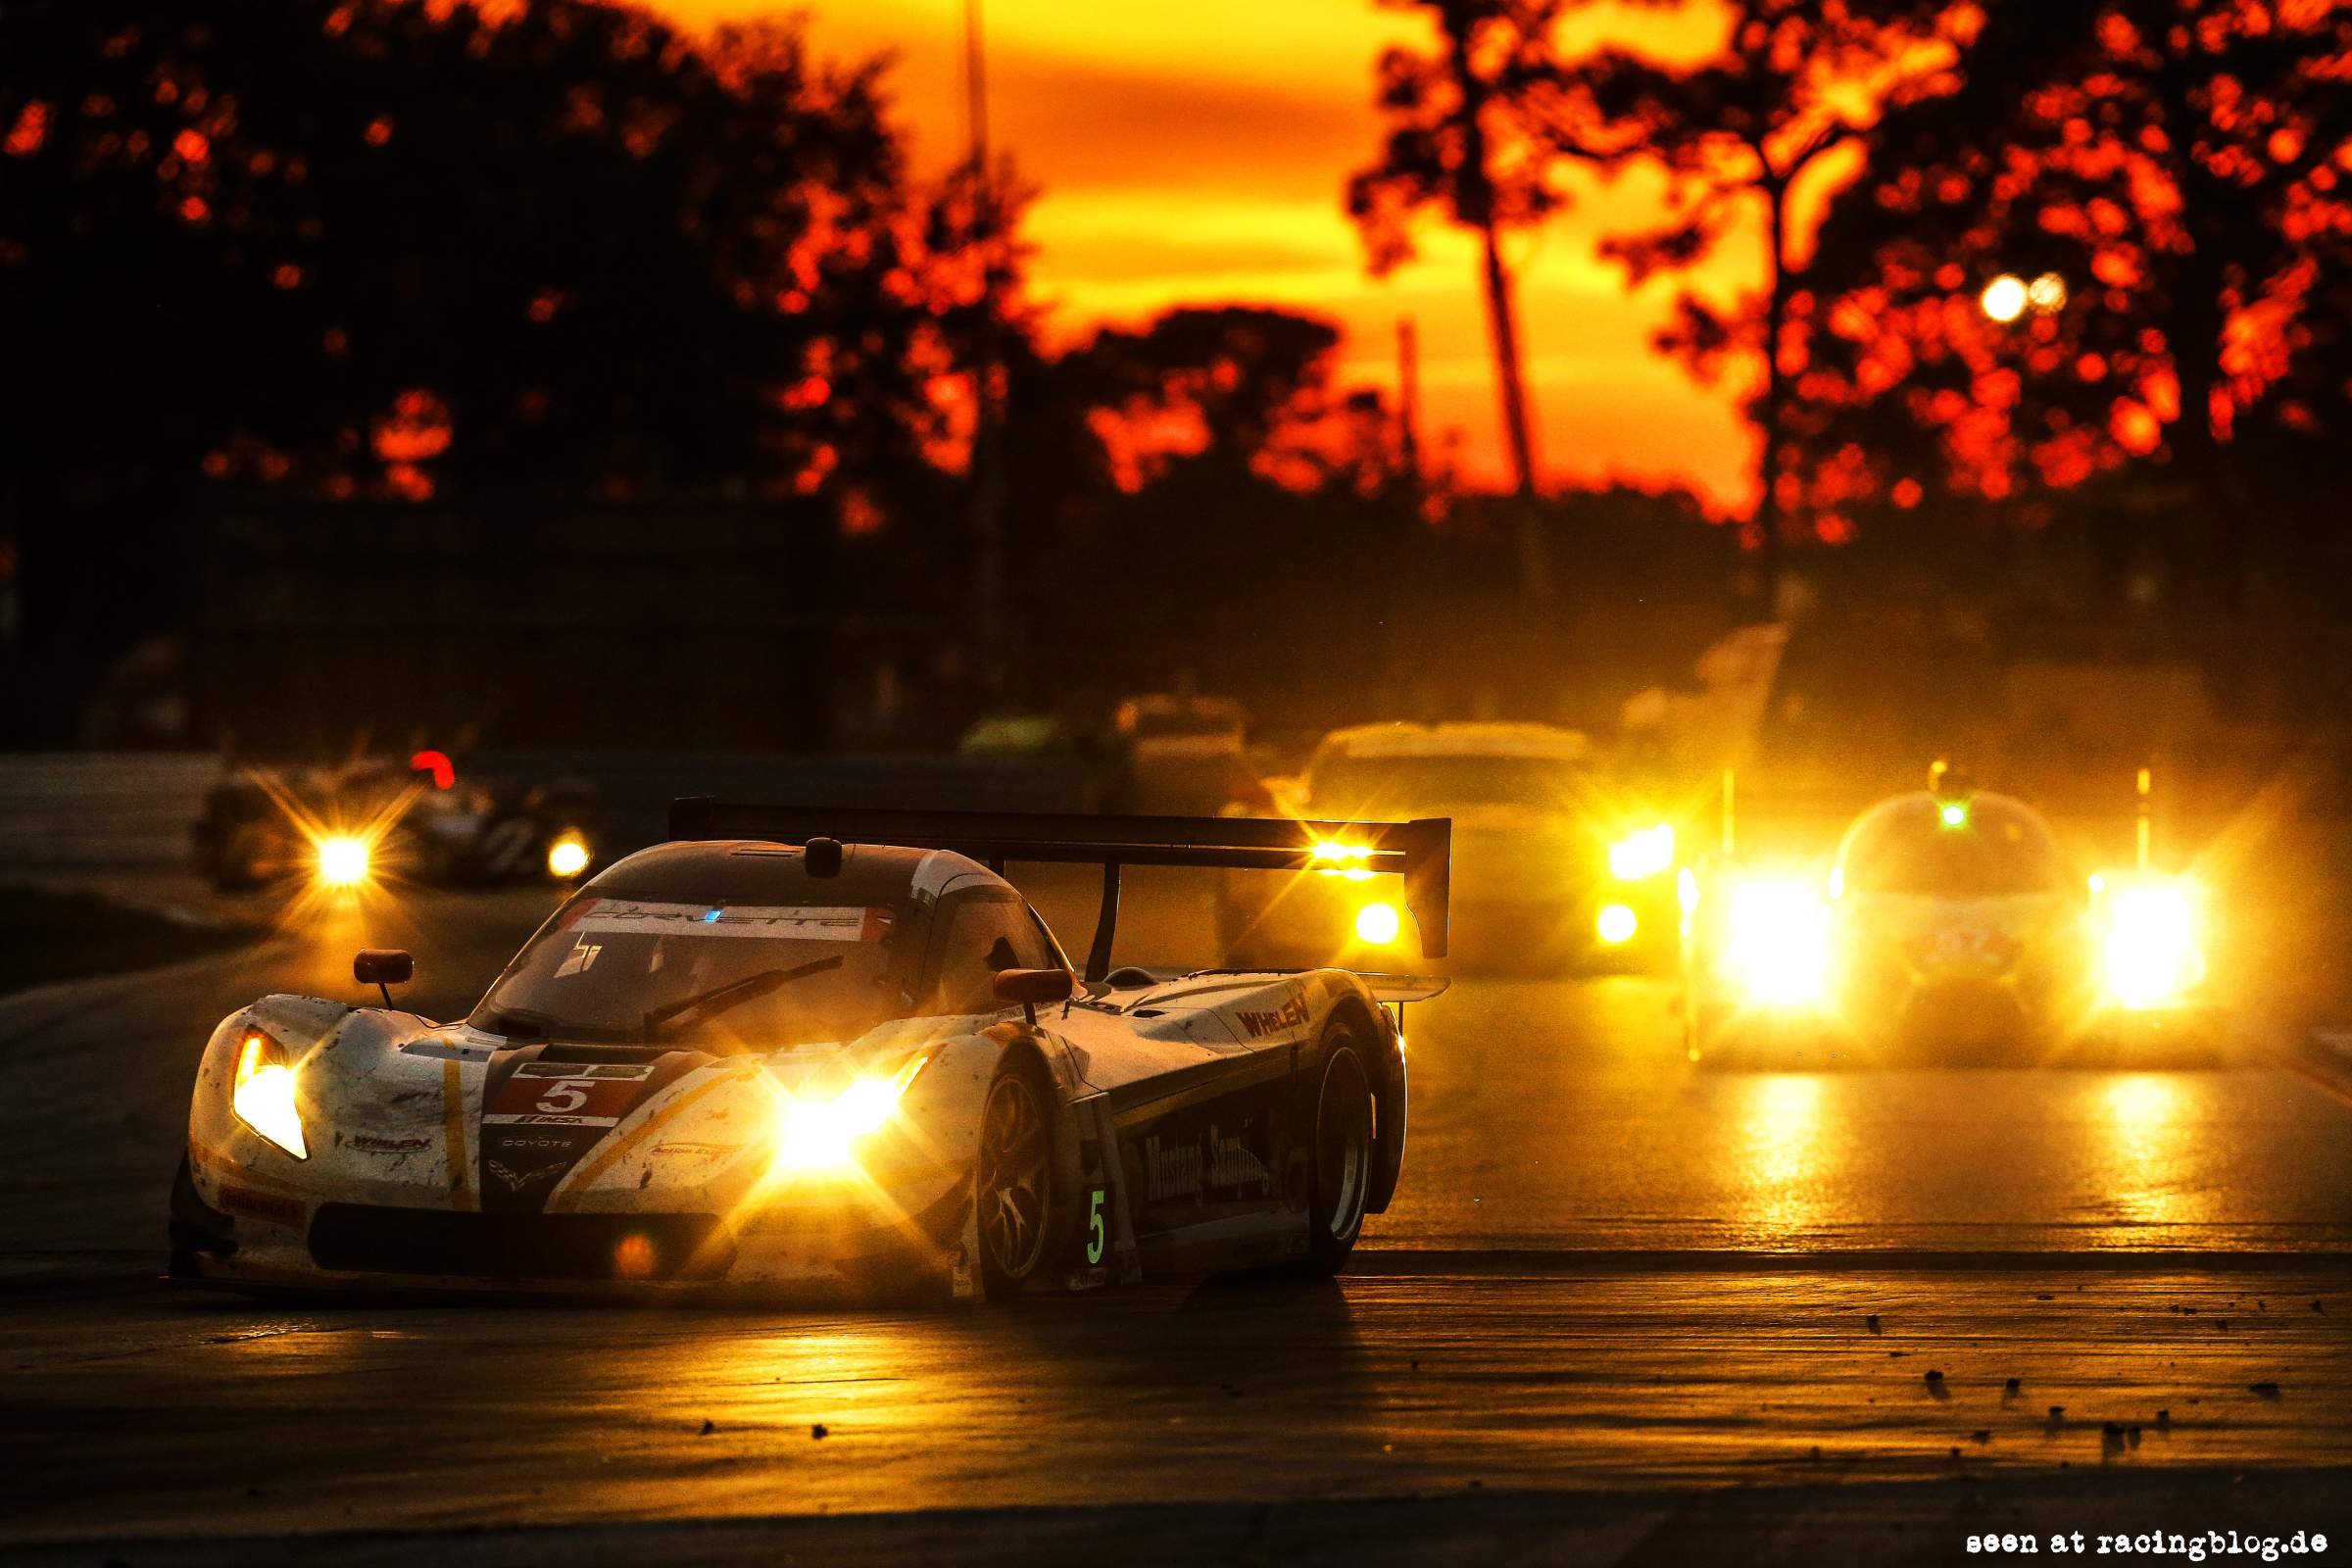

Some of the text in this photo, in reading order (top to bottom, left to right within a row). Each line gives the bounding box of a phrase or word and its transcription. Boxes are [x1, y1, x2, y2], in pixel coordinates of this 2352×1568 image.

[1236, 992, 1310, 1037] WHELEN
[536, 1081, 595, 1112] 5
[1087, 1191, 1104, 1263] 5
